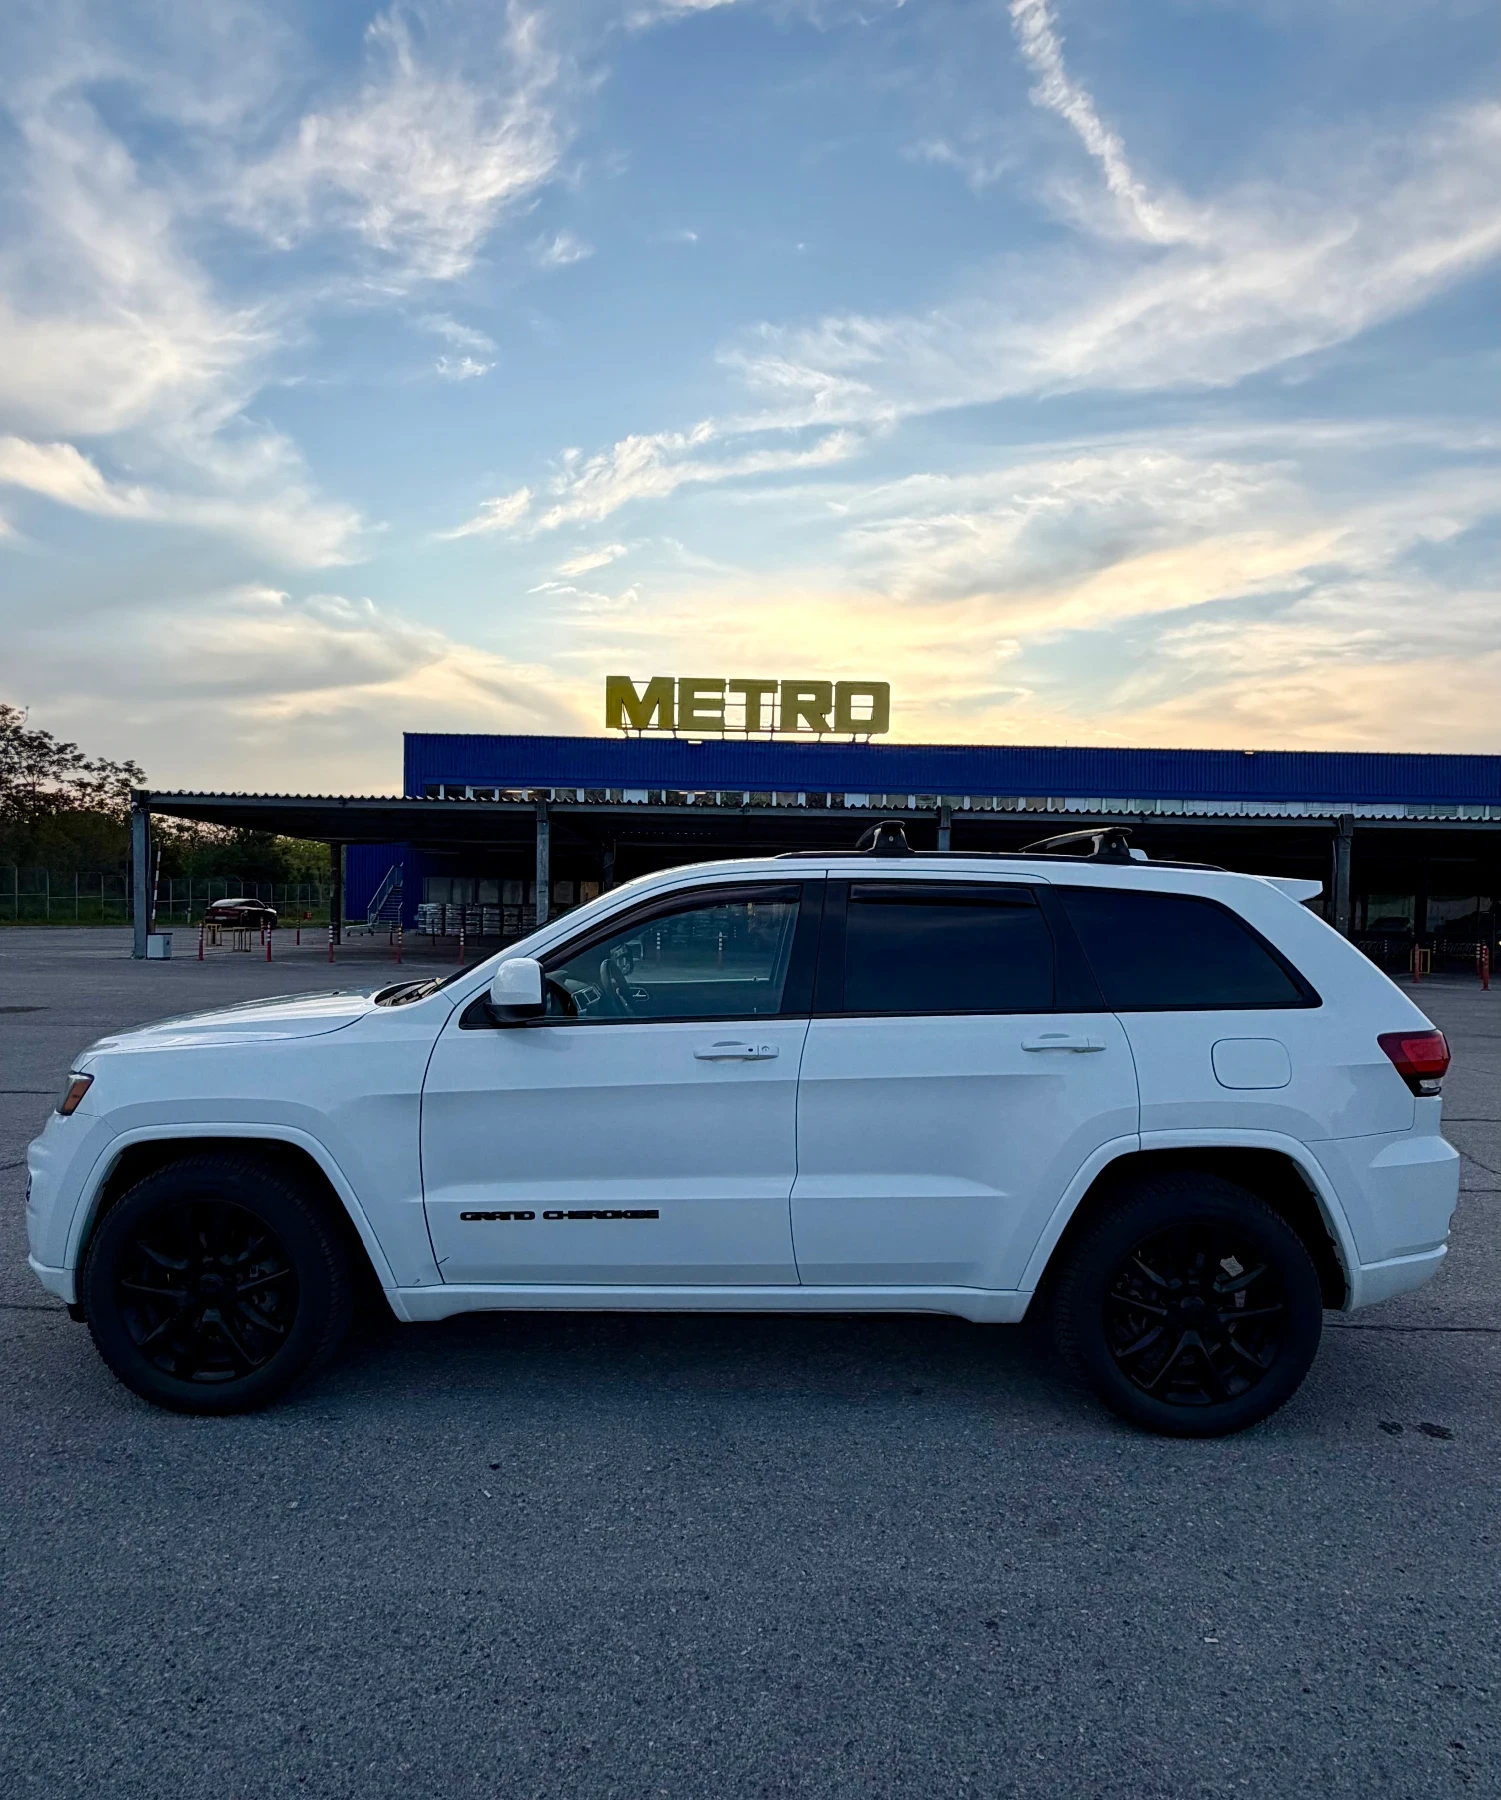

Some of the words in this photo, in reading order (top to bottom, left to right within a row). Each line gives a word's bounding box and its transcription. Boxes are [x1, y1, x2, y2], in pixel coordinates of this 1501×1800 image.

[606, 675, 890, 734] METRO
[460, 1210, 536, 1221] GRAND
[542, 1209, 660, 1220] CHEROKEE
